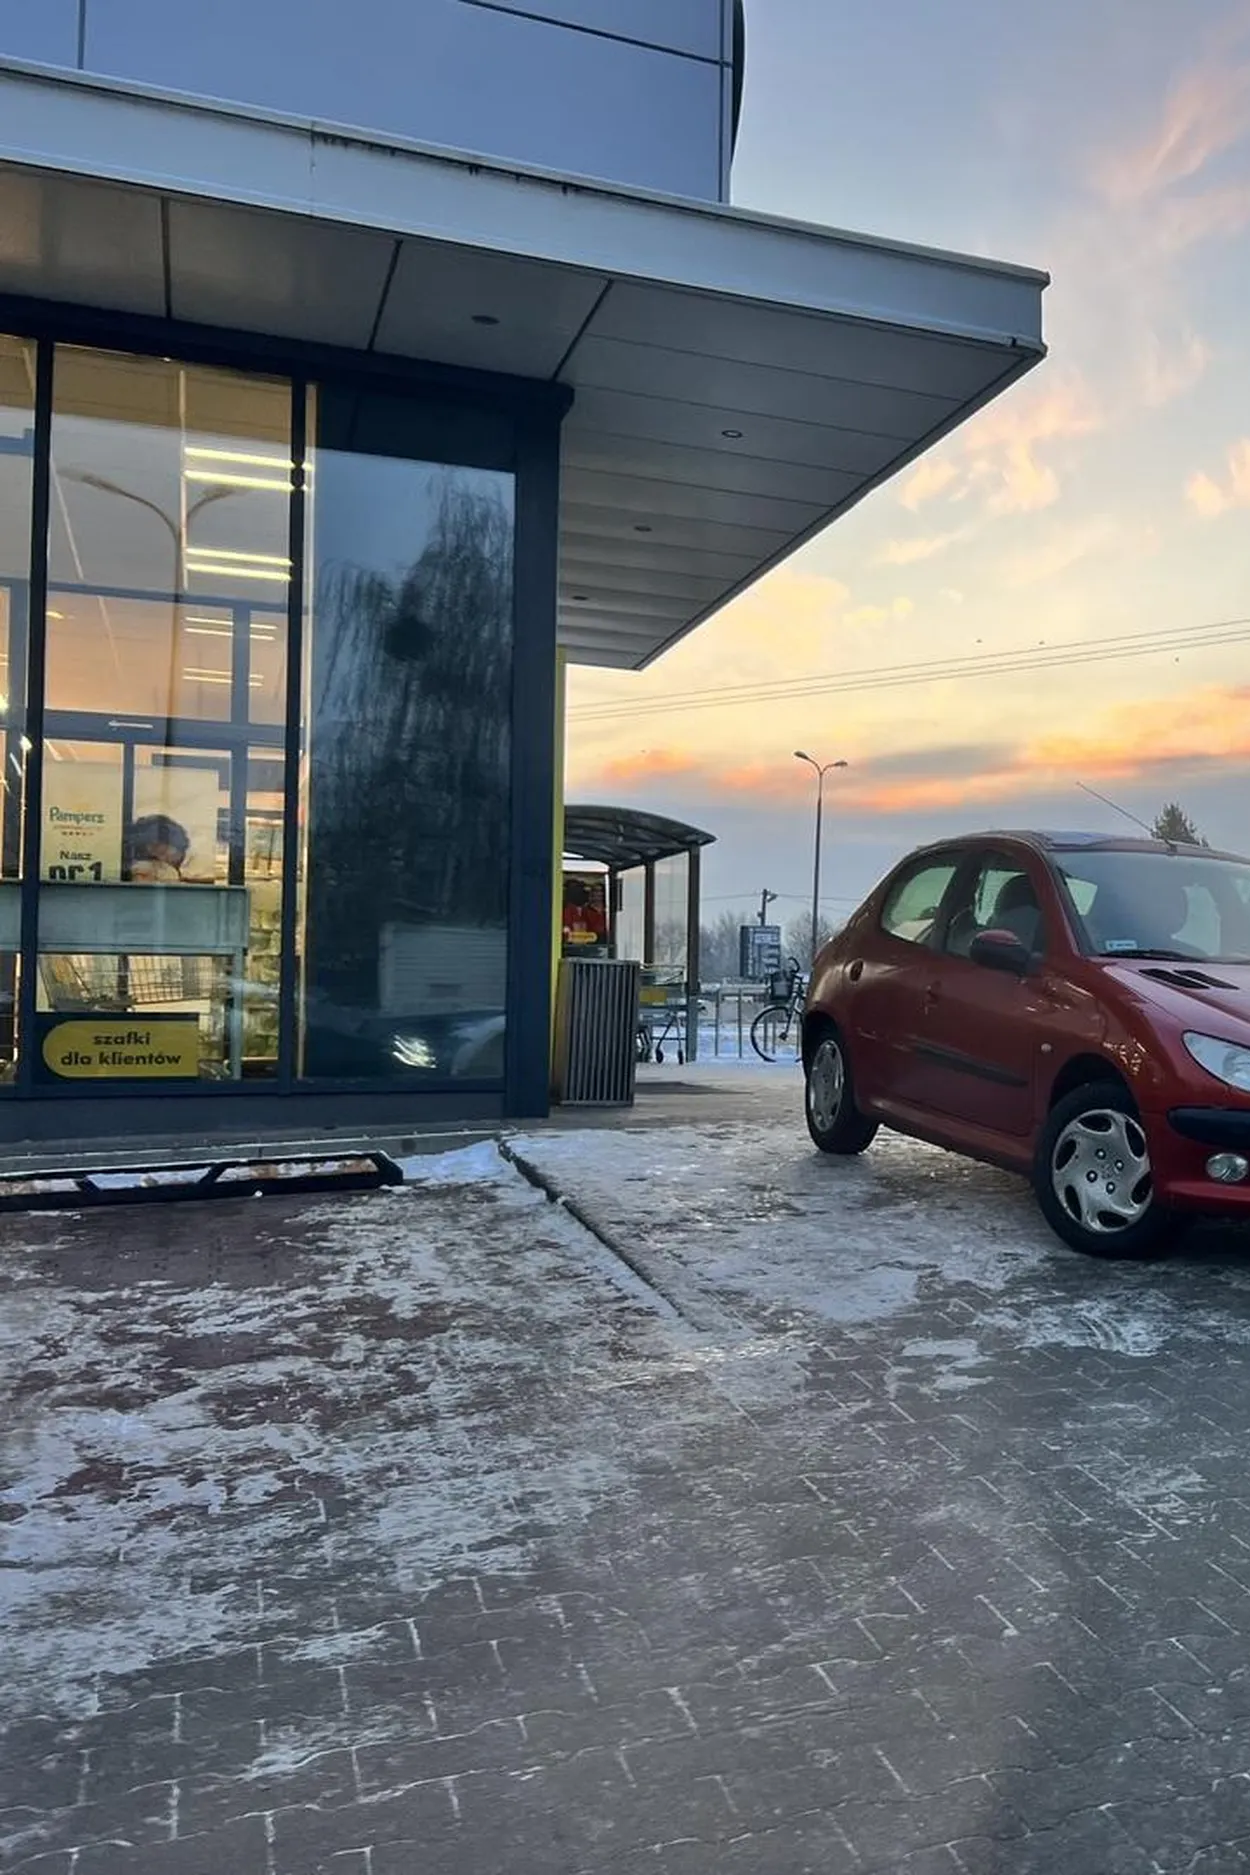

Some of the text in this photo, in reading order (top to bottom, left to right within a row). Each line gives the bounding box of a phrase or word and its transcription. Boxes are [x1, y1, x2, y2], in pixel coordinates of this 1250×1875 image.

[49, 806, 105, 824] Pampers
[60, 851, 92, 860] Nasz
[48, 865, 84, 881] nr
[93, 1032, 151, 1045] szafki
[61, 1051, 181, 1066] dla klientów
